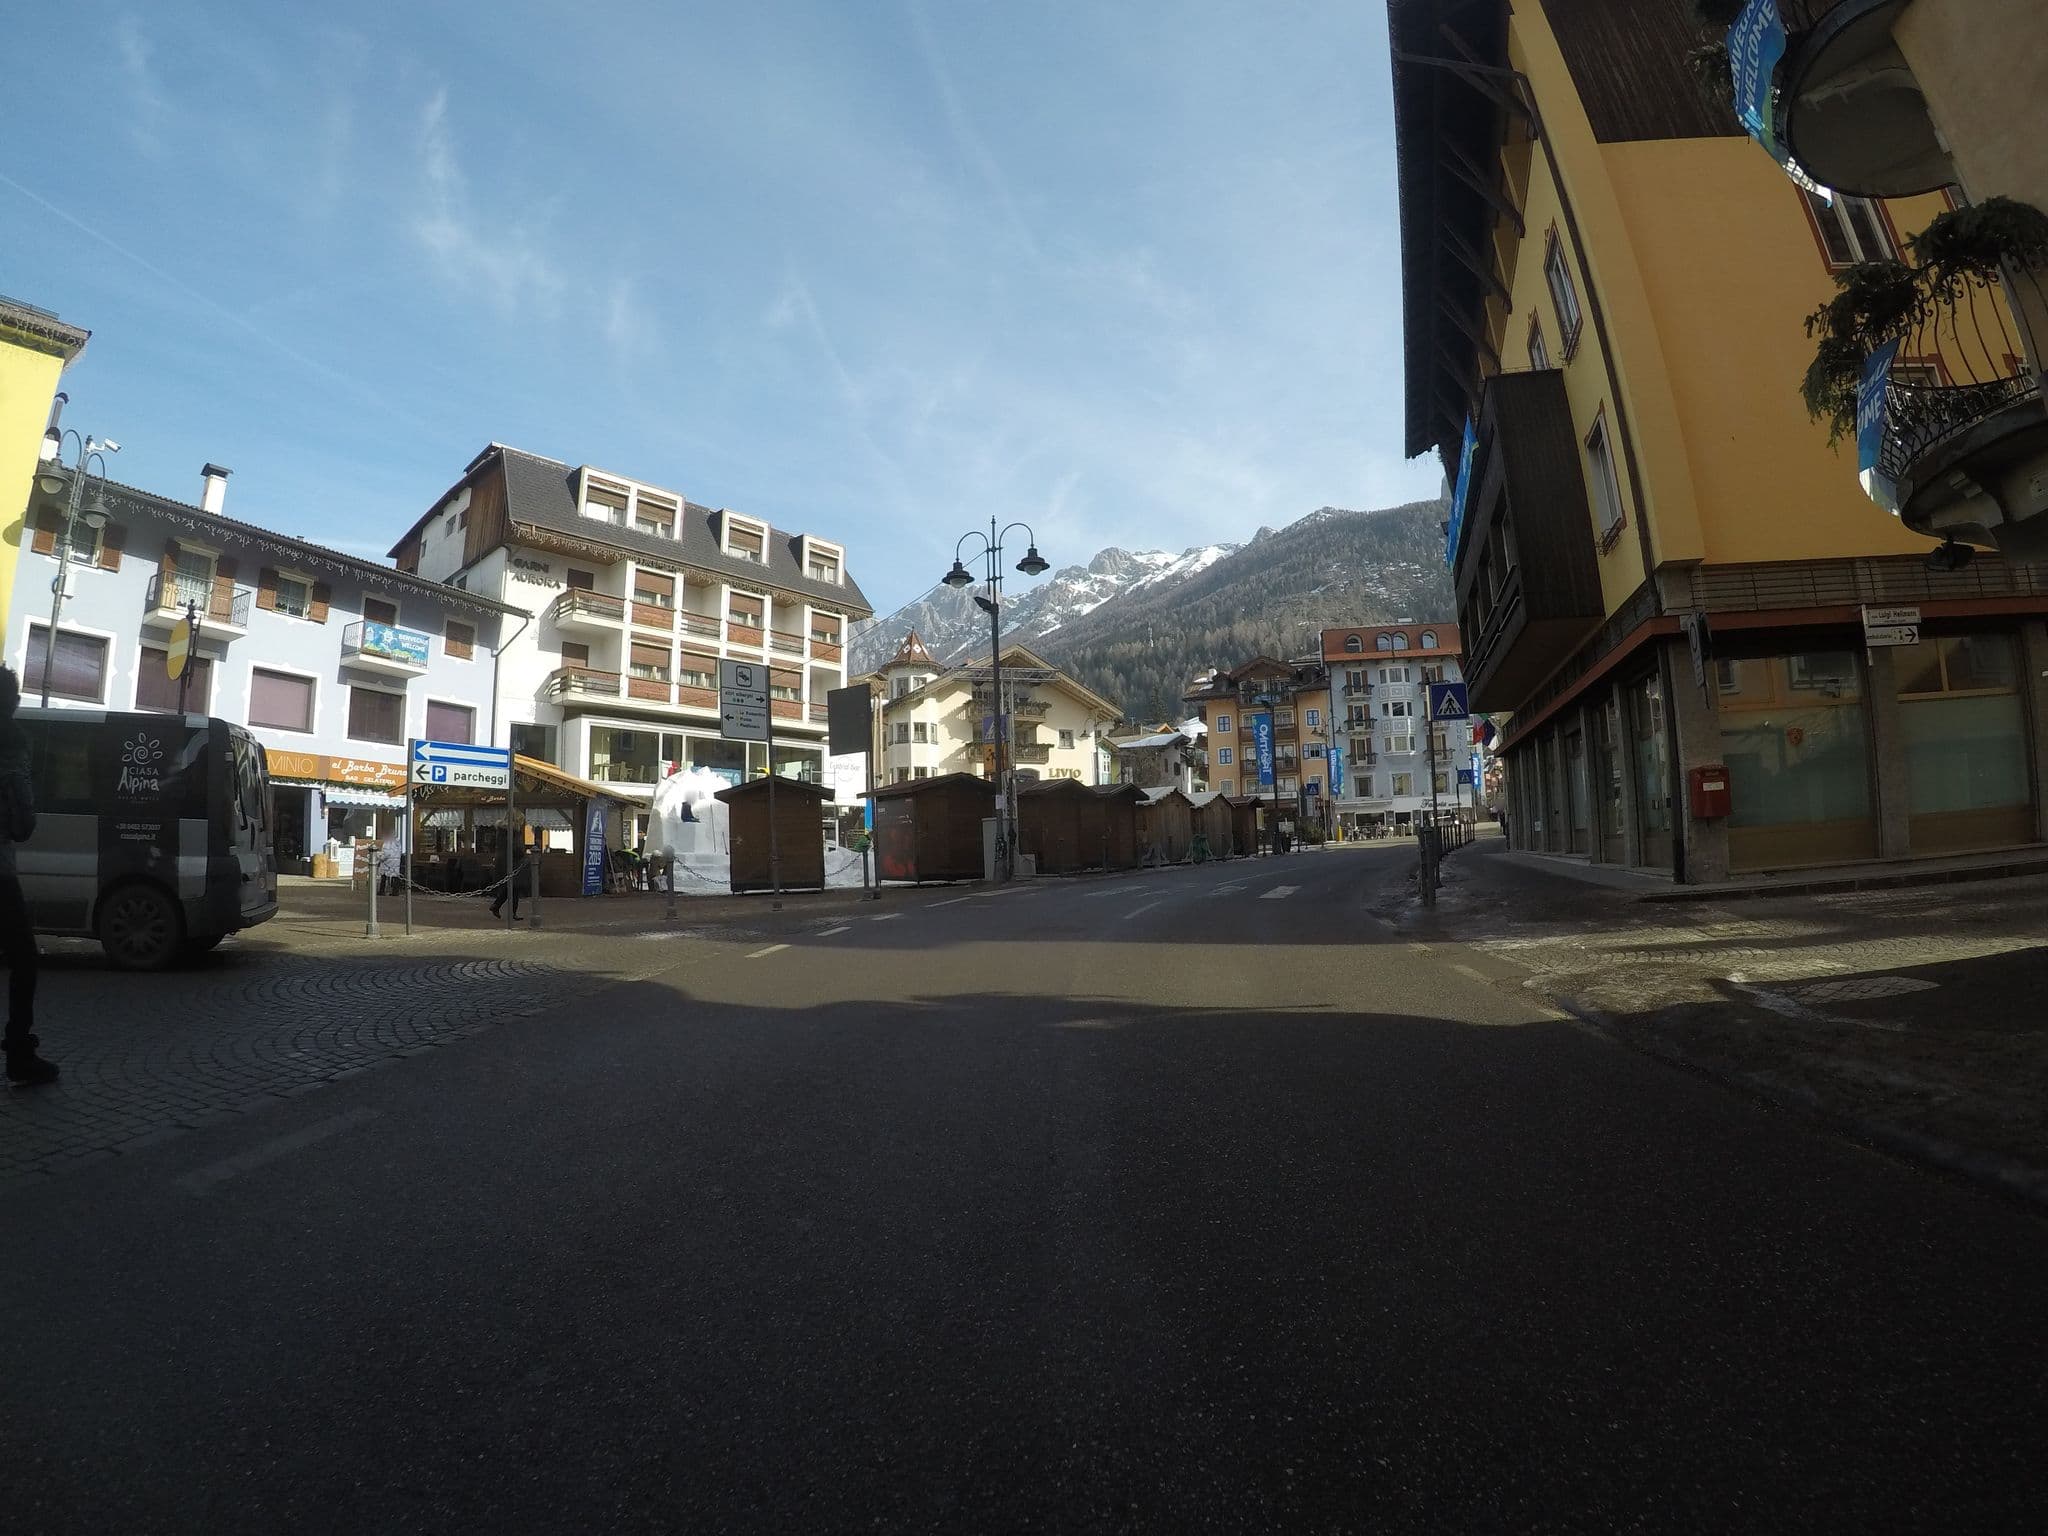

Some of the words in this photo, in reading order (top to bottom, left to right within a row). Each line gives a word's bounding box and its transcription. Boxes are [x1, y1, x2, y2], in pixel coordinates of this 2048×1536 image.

[1744, 0, 1774, 107] WELCOME
[513, 558, 550, 573] GARNI
[511, 571, 561, 590] AURORA
[129, 767, 160, 776] CIASA
[341, 760, 375, 775] Barba
[375, 764, 408, 778] Bruno
[434, 767, 444, 779] P
[453, 772, 507, 786] parcheggi
[1048, 767, 1082, 779] LIVIO
[117, 766, 160, 794] Alpina
[588, 851, 602, 866] 2019
